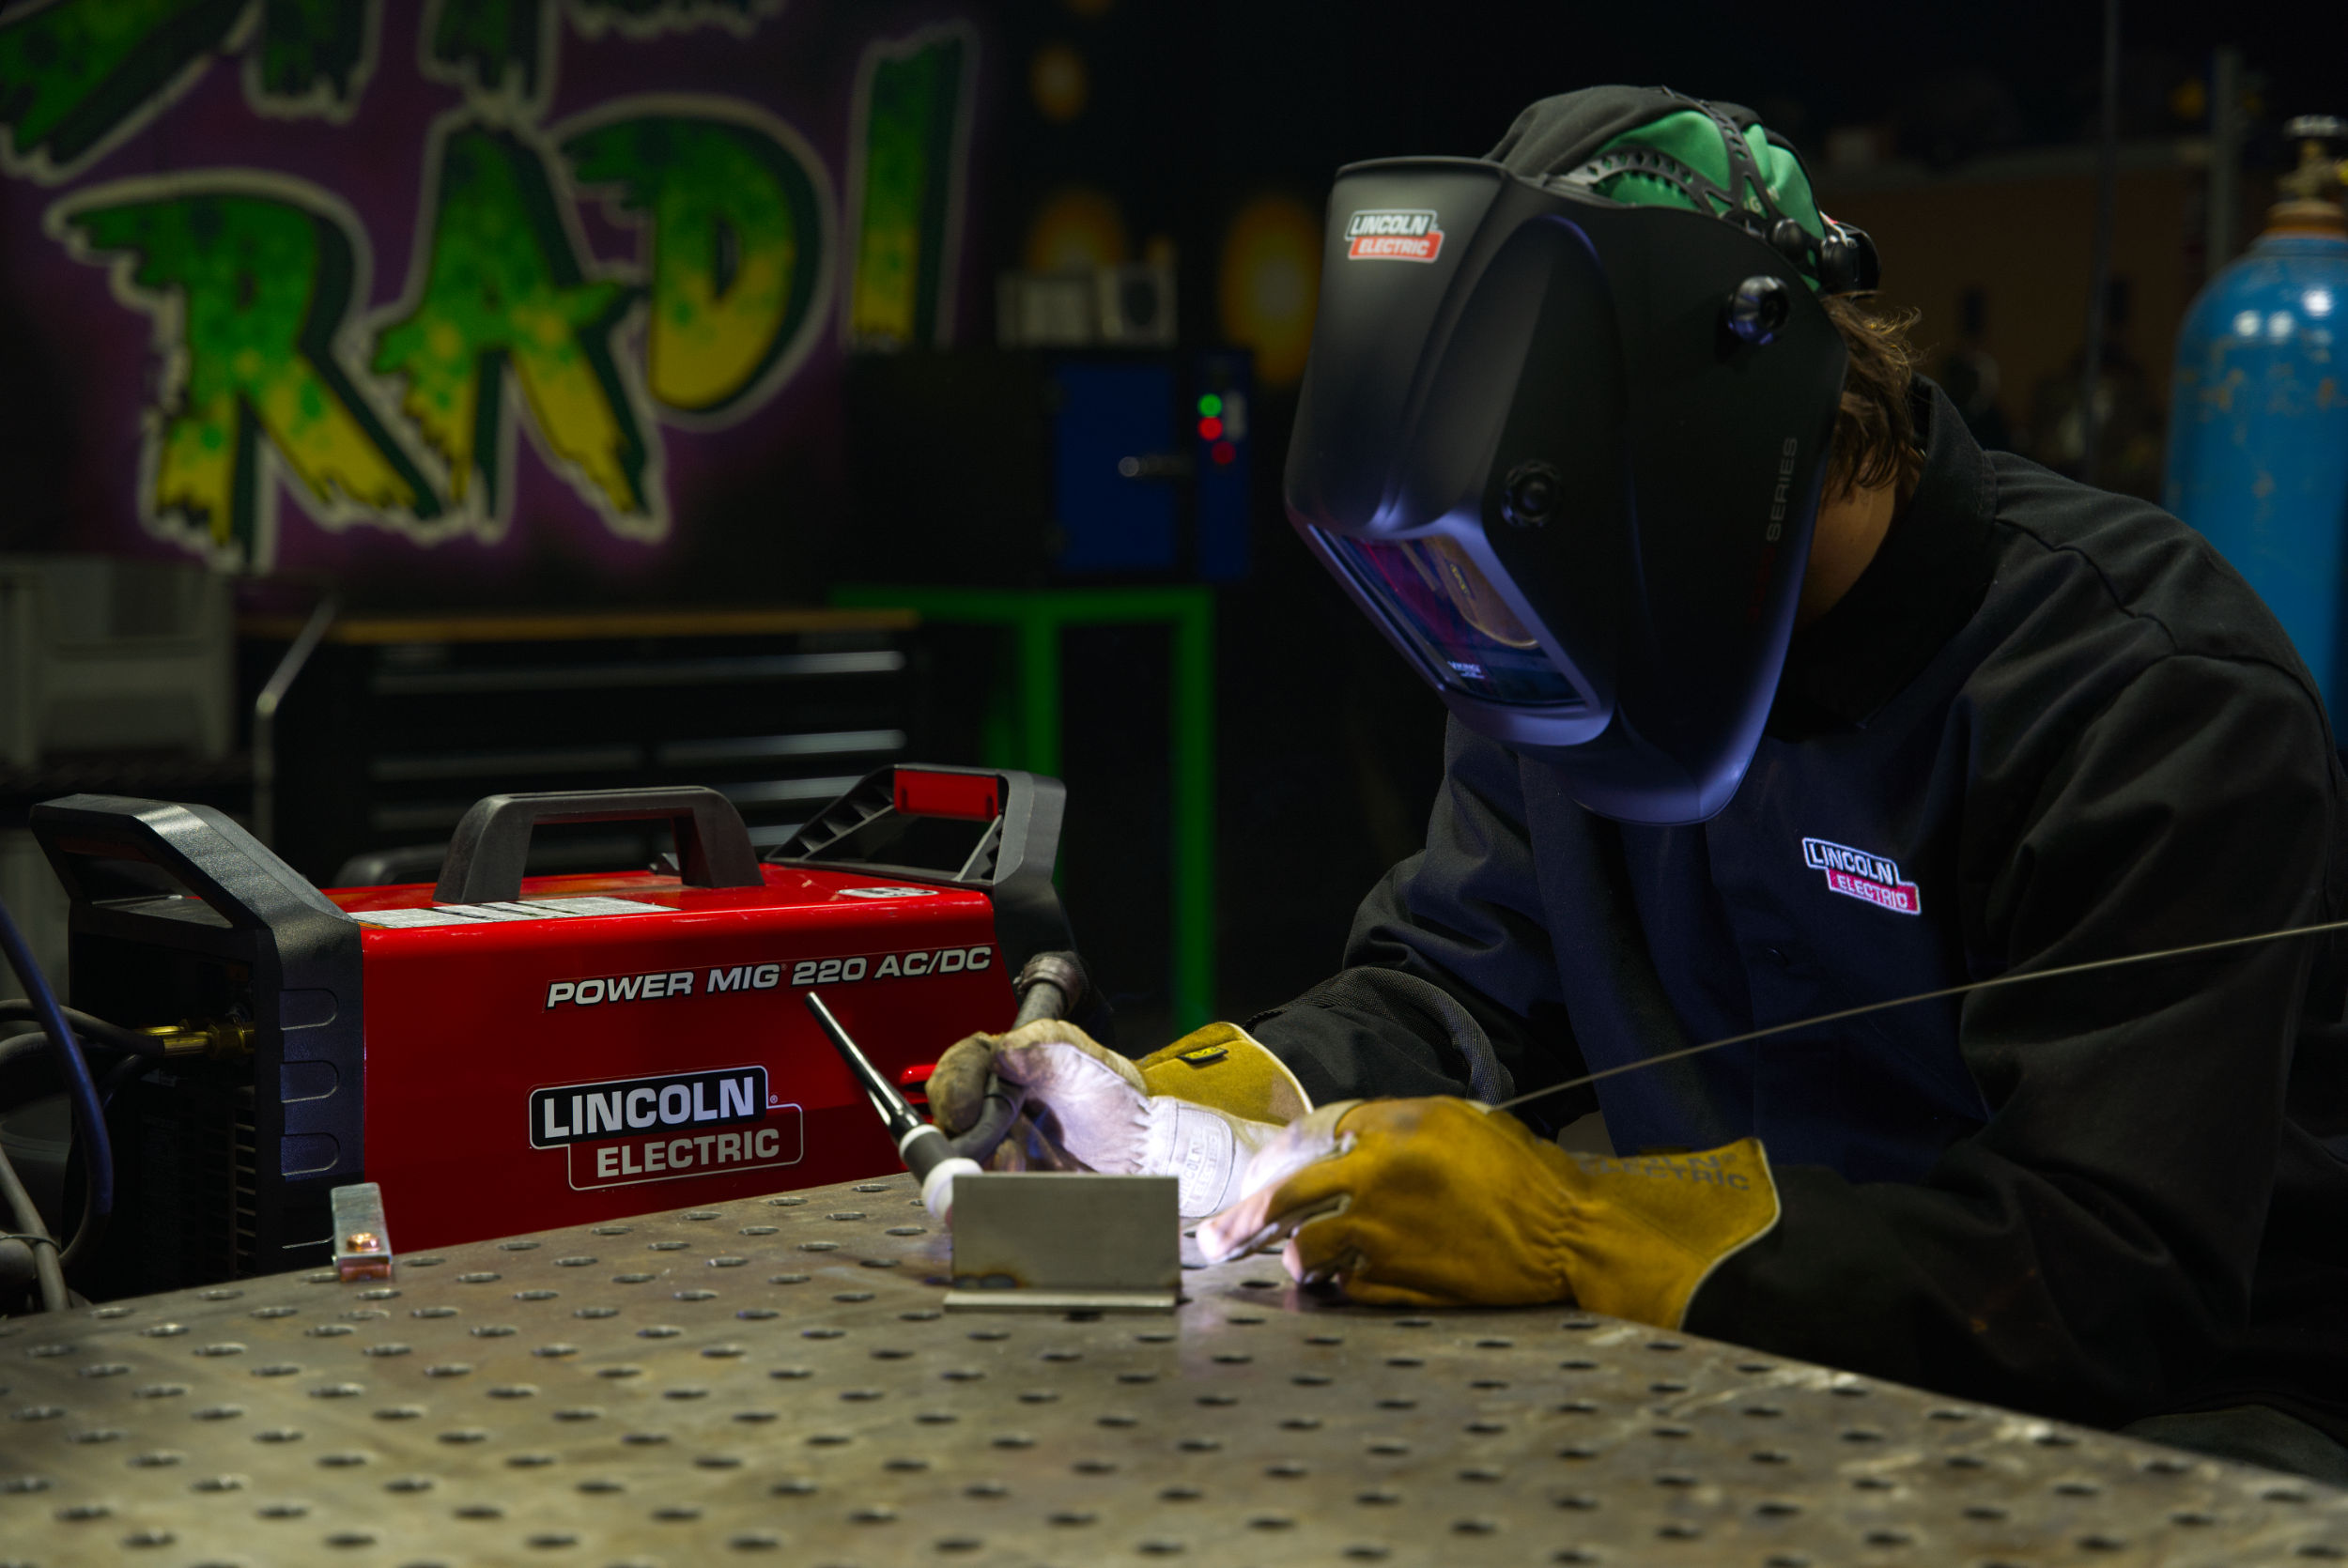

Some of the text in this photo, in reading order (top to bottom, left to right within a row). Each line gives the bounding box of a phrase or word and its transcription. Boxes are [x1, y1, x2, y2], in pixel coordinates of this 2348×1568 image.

[1350, 214, 1430, 236] LINCOLN
[1358, 238, 1430, 256] ELECTRIC
[1766, 437, 1798, 542] SERIES
[1809, 842, 1894, 886] LINCOLN
[1836, 873, 1908, 910] ELECTRIC
[546, 971, 695, 1009] POWER
[791, 957, 868, 986] 220
[873, 945, 993, 979] AC/DC
[544, 1076, 755, 1139] LINCOLN
[596, 1128, 780, 1178] ELECTRIC
